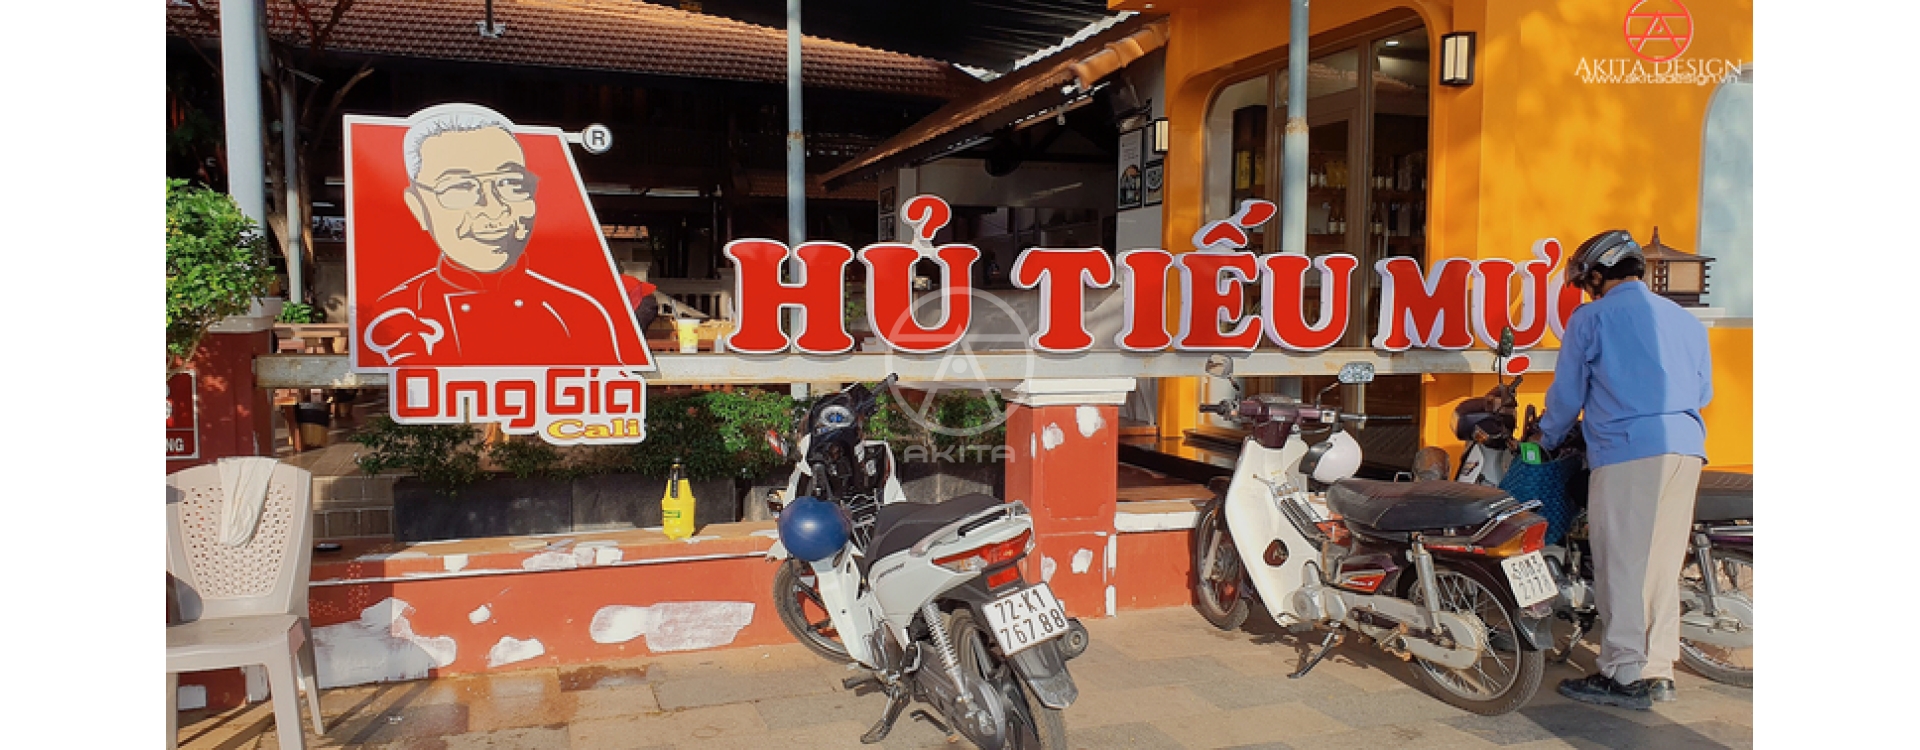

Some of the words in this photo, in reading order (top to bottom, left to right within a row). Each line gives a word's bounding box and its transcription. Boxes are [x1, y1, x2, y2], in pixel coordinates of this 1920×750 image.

[724, 195, 981, 353] HỦ
[1011, 200, 1358, 352] TIẾU
[547, 417, 641, 440] Cali
